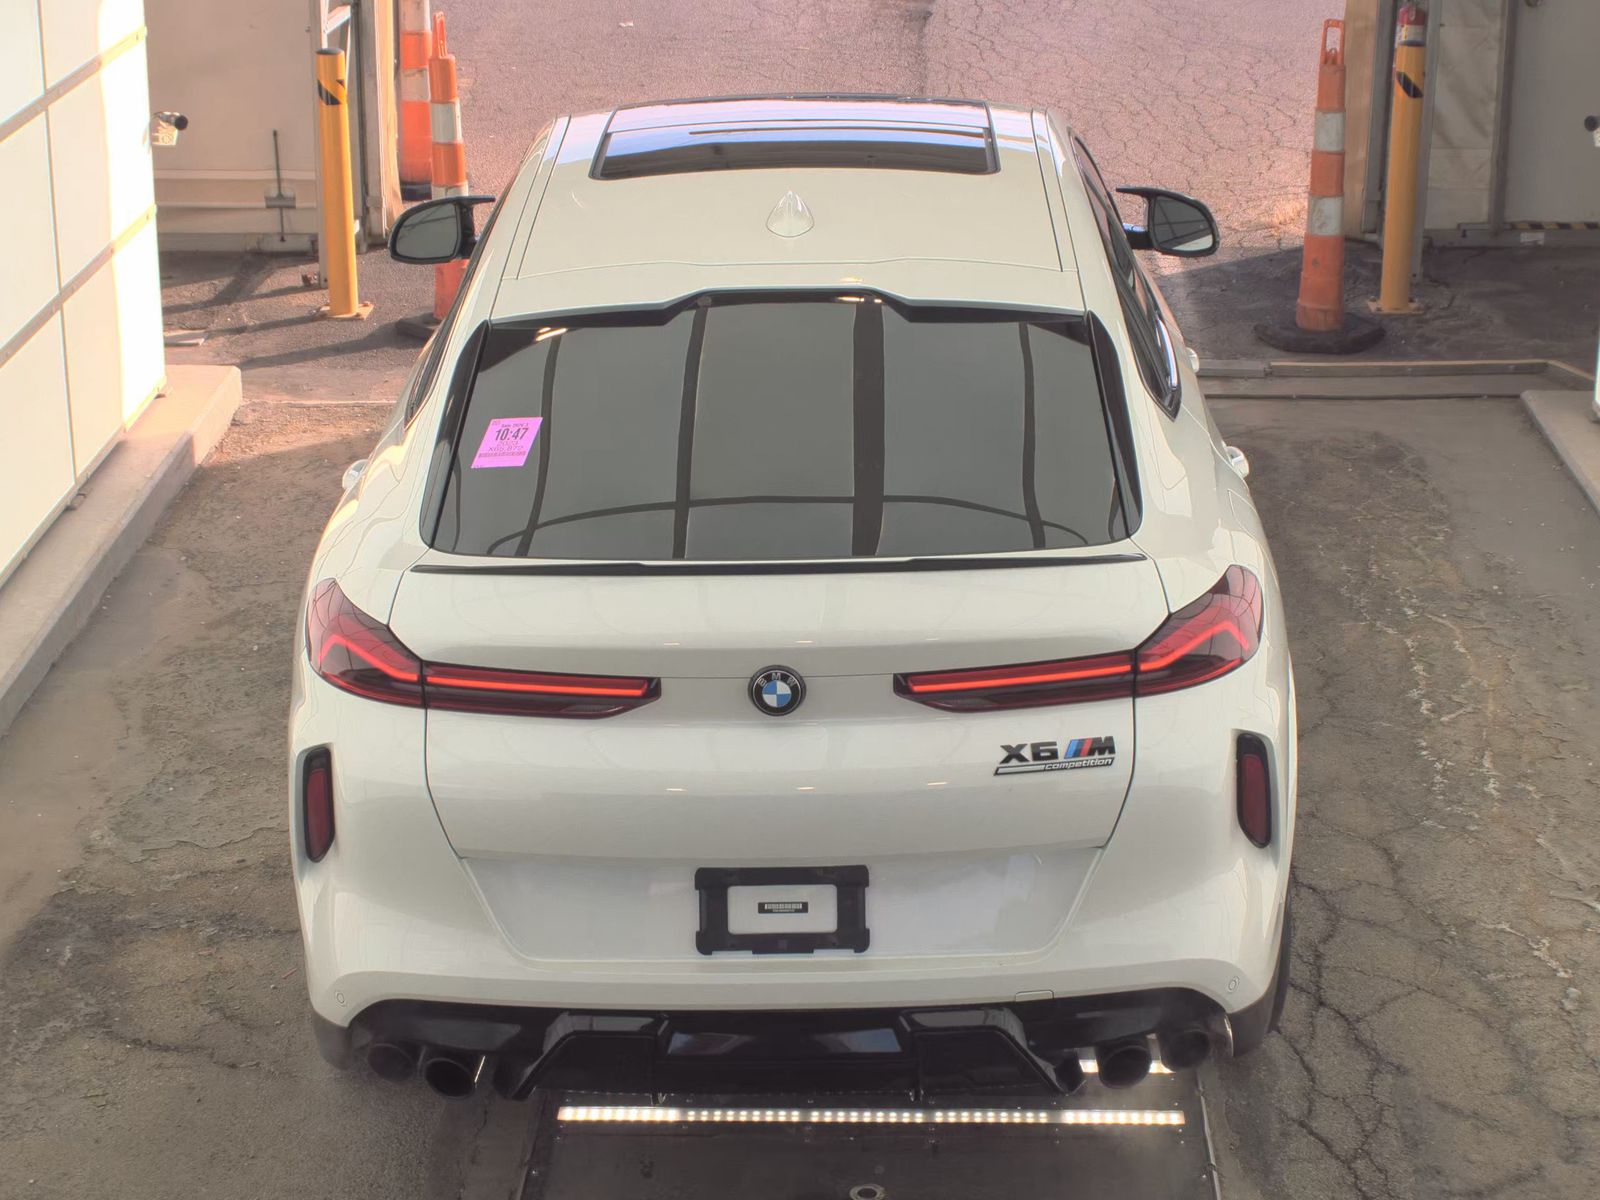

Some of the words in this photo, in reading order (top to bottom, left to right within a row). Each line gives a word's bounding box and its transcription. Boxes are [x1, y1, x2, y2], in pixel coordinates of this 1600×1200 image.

[495, 427, 529, 441] 10:47
[757, 672, 797, 688] BMW
[999, 741, 1060, 765] X6
[1084, 735, 1116, 758] M
[1045, 758, 1112, 771] competition
